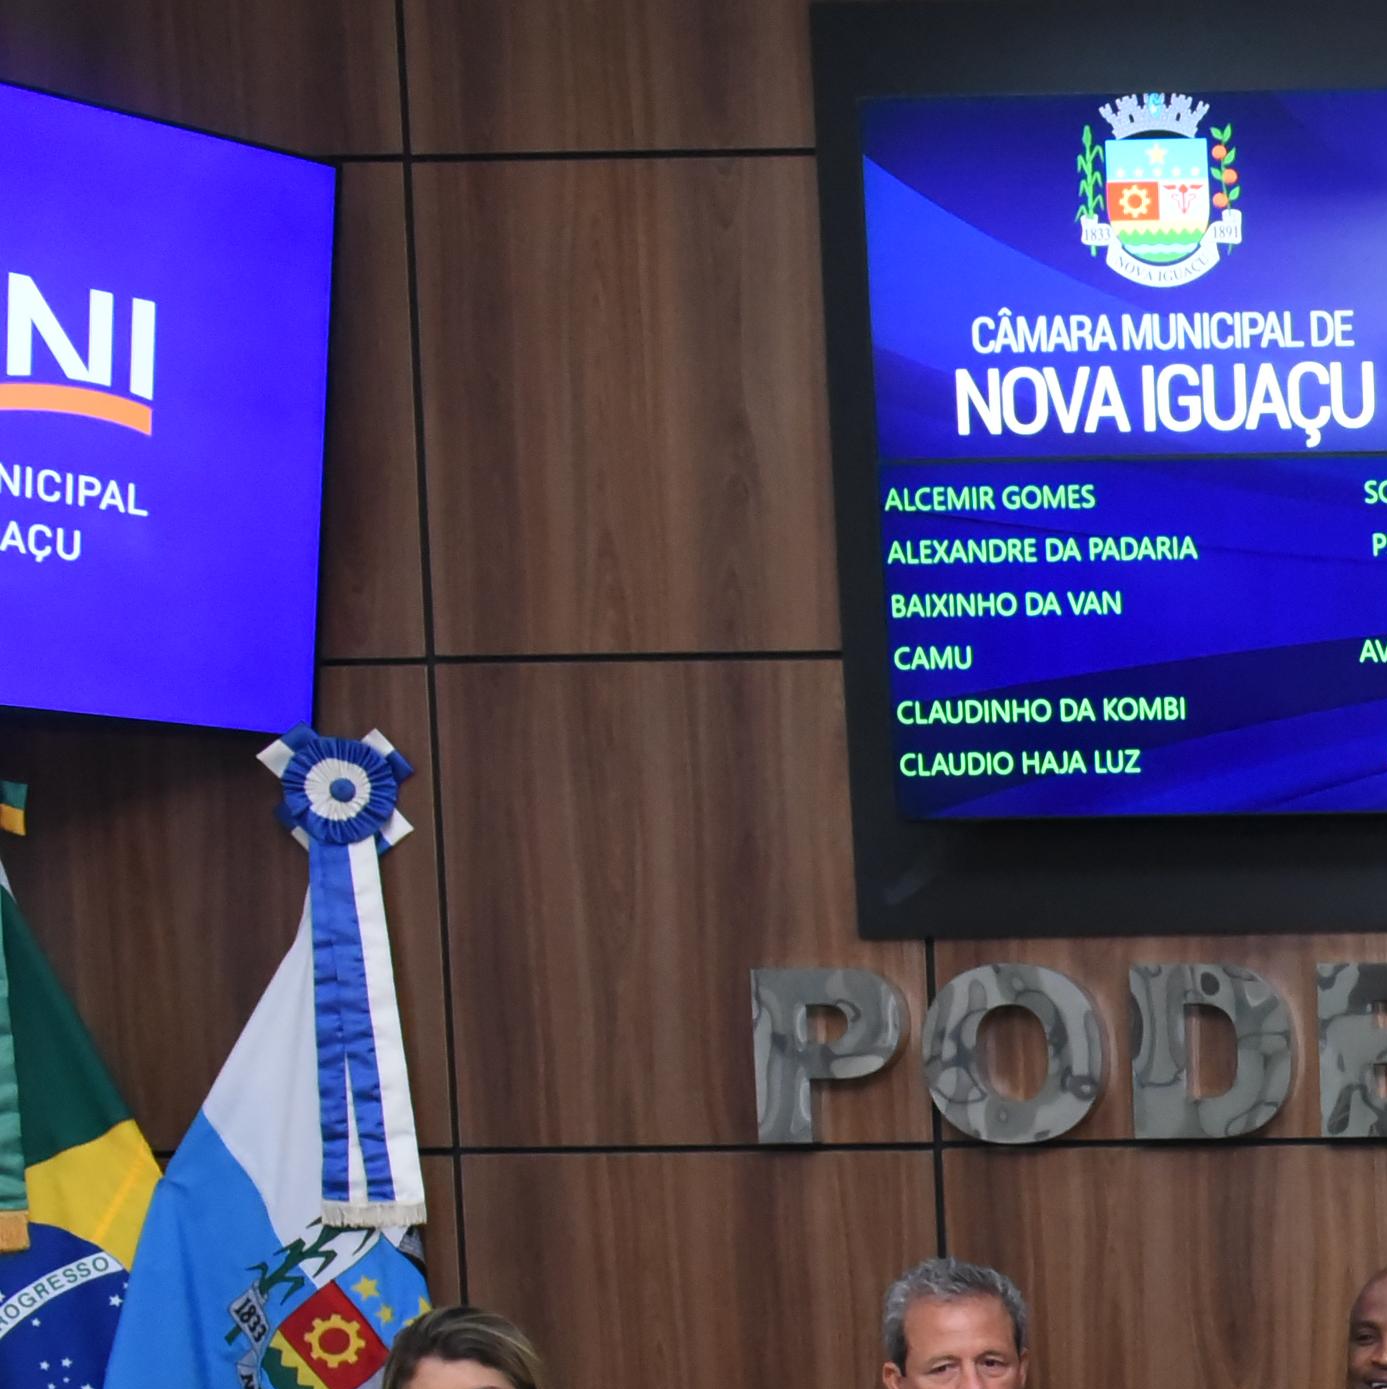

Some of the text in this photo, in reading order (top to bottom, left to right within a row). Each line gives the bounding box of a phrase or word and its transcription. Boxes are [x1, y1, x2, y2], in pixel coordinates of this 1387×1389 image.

[1084, 227, 1111, 241] 1833
[1212, 226, 1238, 239] 1891
[971, 306, 1356, 355] CÂMARA MUNICIPAL DE
[954, 360, 1376, 449] NOVA IGUAÇU
[884, 483, 1096, 512] ALCEMIR GOMES
[887, 535, 1199, 565] ALEXANDRE DA PADARIA
[890, 590, 1122, 619] BAIXINHO DA VAN
[893, 645, 973, 671] CAMU
[896, 696, 1186, 725] CLAUDINHO DA KOMBI
[899, 748, 1142, 777] CLAUDIO HAJA LUZ
[235, 1298, 266, 1342] 1833
